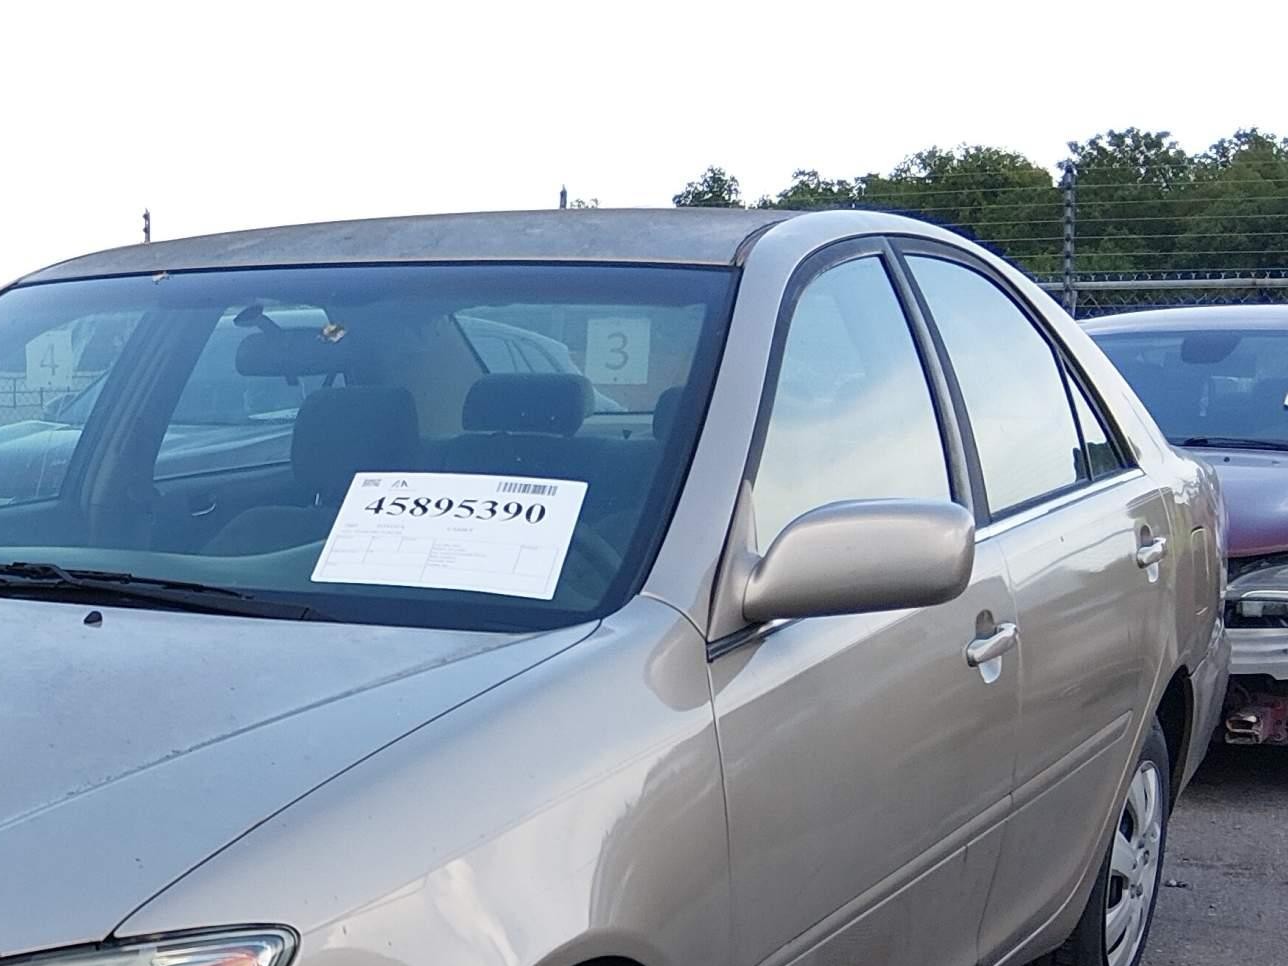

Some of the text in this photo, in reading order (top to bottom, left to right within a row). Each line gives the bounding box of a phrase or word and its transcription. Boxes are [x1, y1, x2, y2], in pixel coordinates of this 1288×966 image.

[40, 343, 59, 376] 4
[607, 332, 629, 370] 3
[365, 496, 546, 524] 45895390
